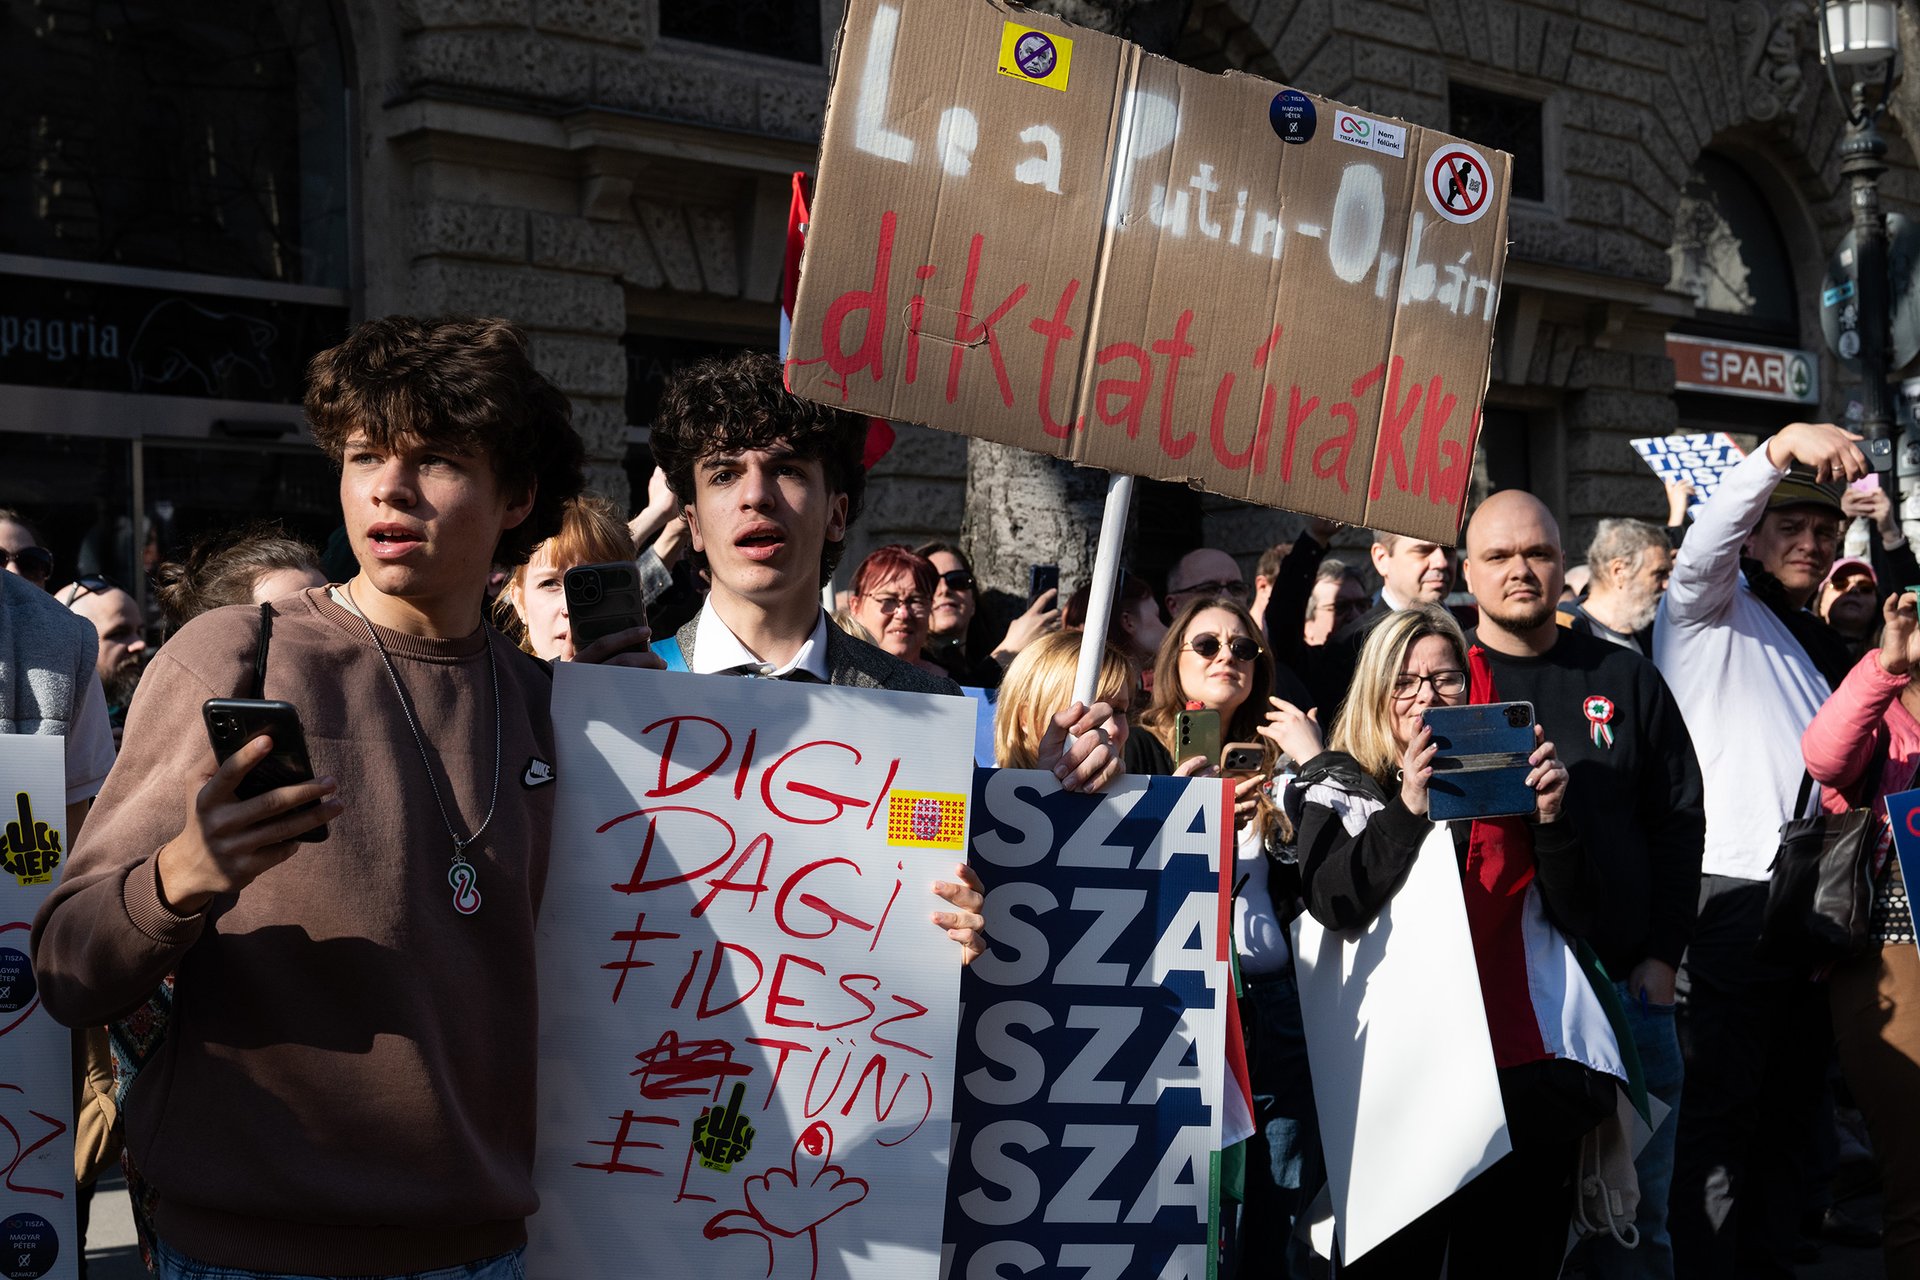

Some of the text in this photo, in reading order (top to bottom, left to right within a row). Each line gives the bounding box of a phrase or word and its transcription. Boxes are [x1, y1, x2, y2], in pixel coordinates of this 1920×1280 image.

[1340, 134, 1369, 146] TISZA PÁRT
[1377, 138, 1400, 150] félünk!
[1378, 130, 1395, 140] Nem
[856, 4, 1495, 321] Le a Putin-Orbán
[1701, 351, 1785, 388] SPAR
[1630, 432, 1738, 455] TISZA
[530, 759, 551, 777] NIKE
[641, 715, 900, 829] DIGI
[692, 1083, 755, 1151] FUCK
[694, 1137, 747, 1164] NER
[13, 1241, 36, 1249] PÉTER
